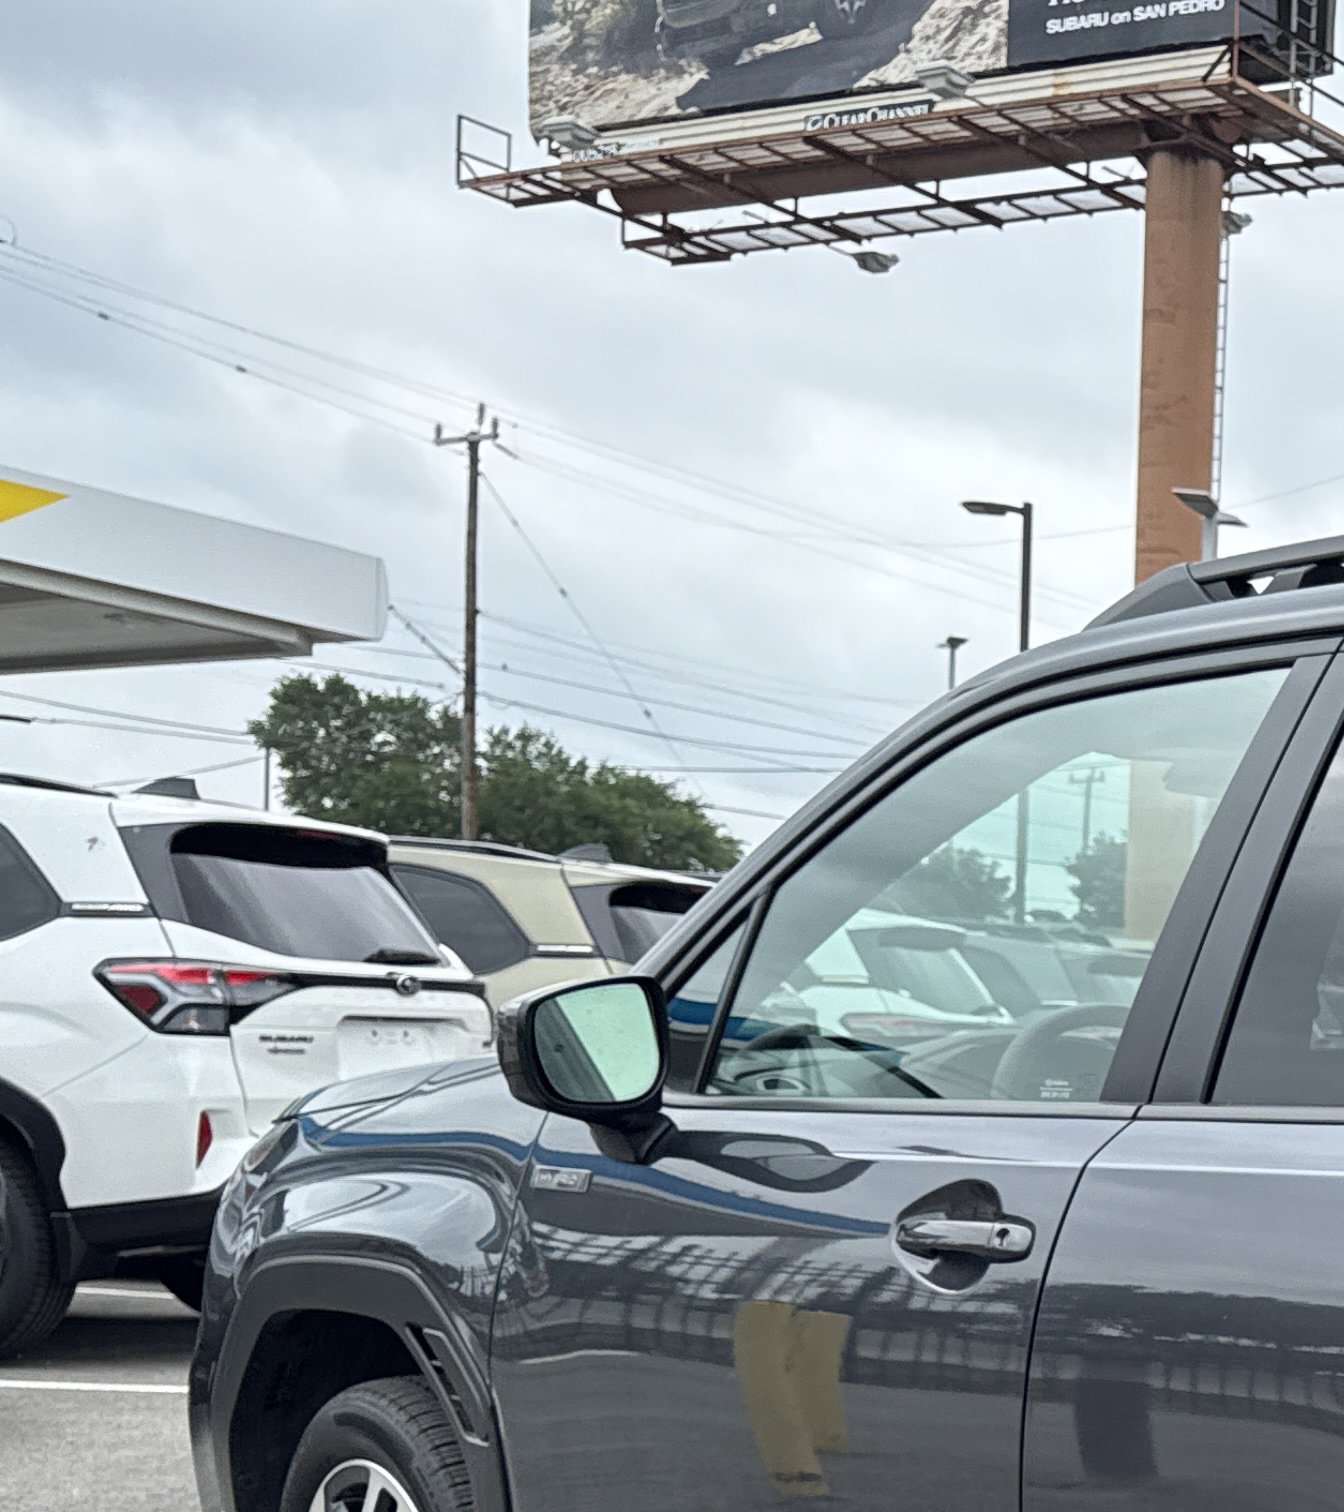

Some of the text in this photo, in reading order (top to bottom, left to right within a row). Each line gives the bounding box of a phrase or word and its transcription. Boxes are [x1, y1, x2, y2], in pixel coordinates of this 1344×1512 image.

[1045, 0, 1225, 34] SUBARU on SAN PEDRO
